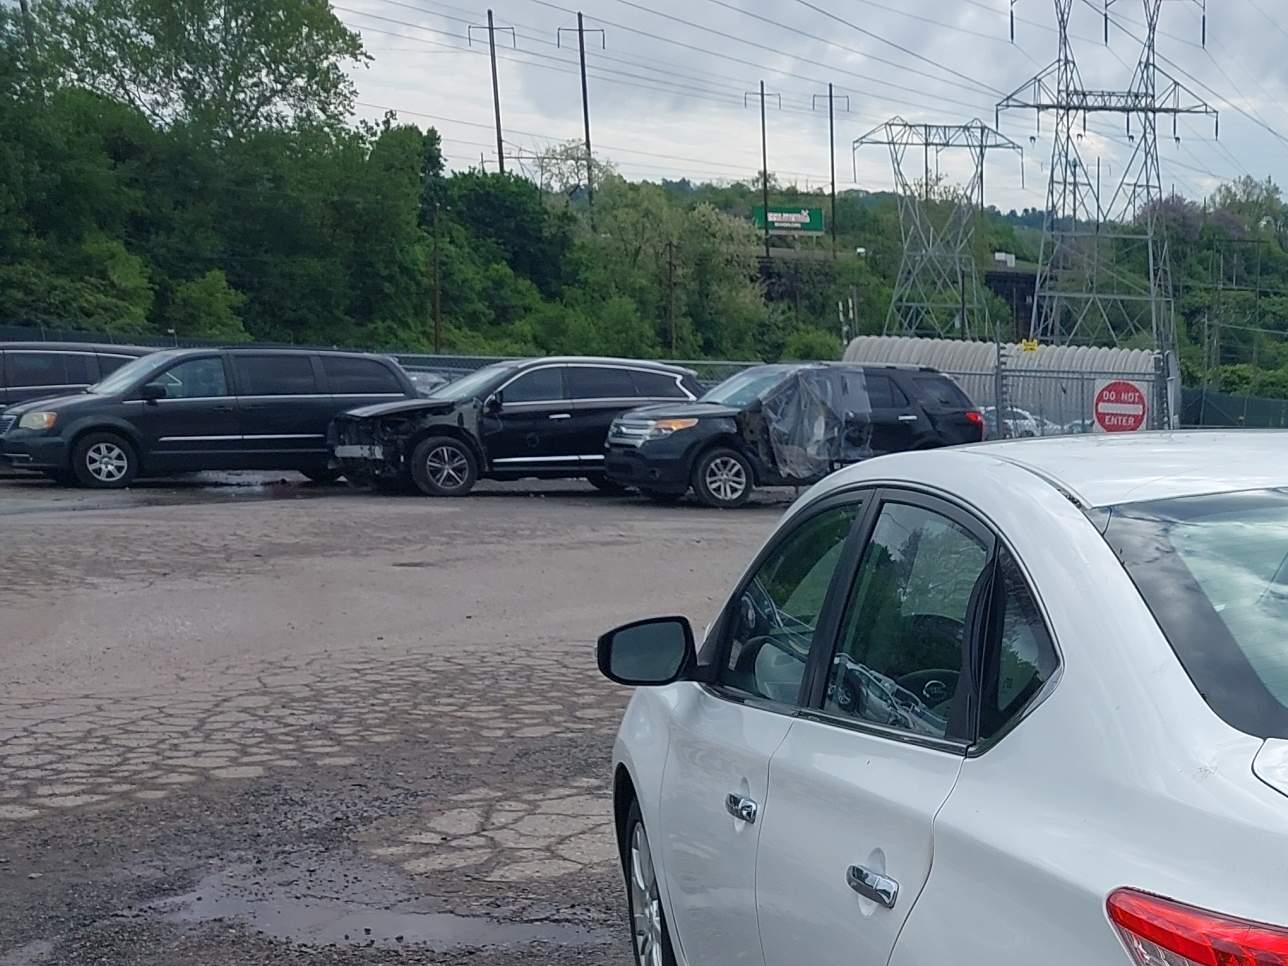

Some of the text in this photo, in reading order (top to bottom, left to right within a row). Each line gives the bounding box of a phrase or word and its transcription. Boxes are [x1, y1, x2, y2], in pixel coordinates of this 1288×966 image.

[1103, 392, 1139, 401] DO NOT
[1105, 415, 1135, 425] ENTER
